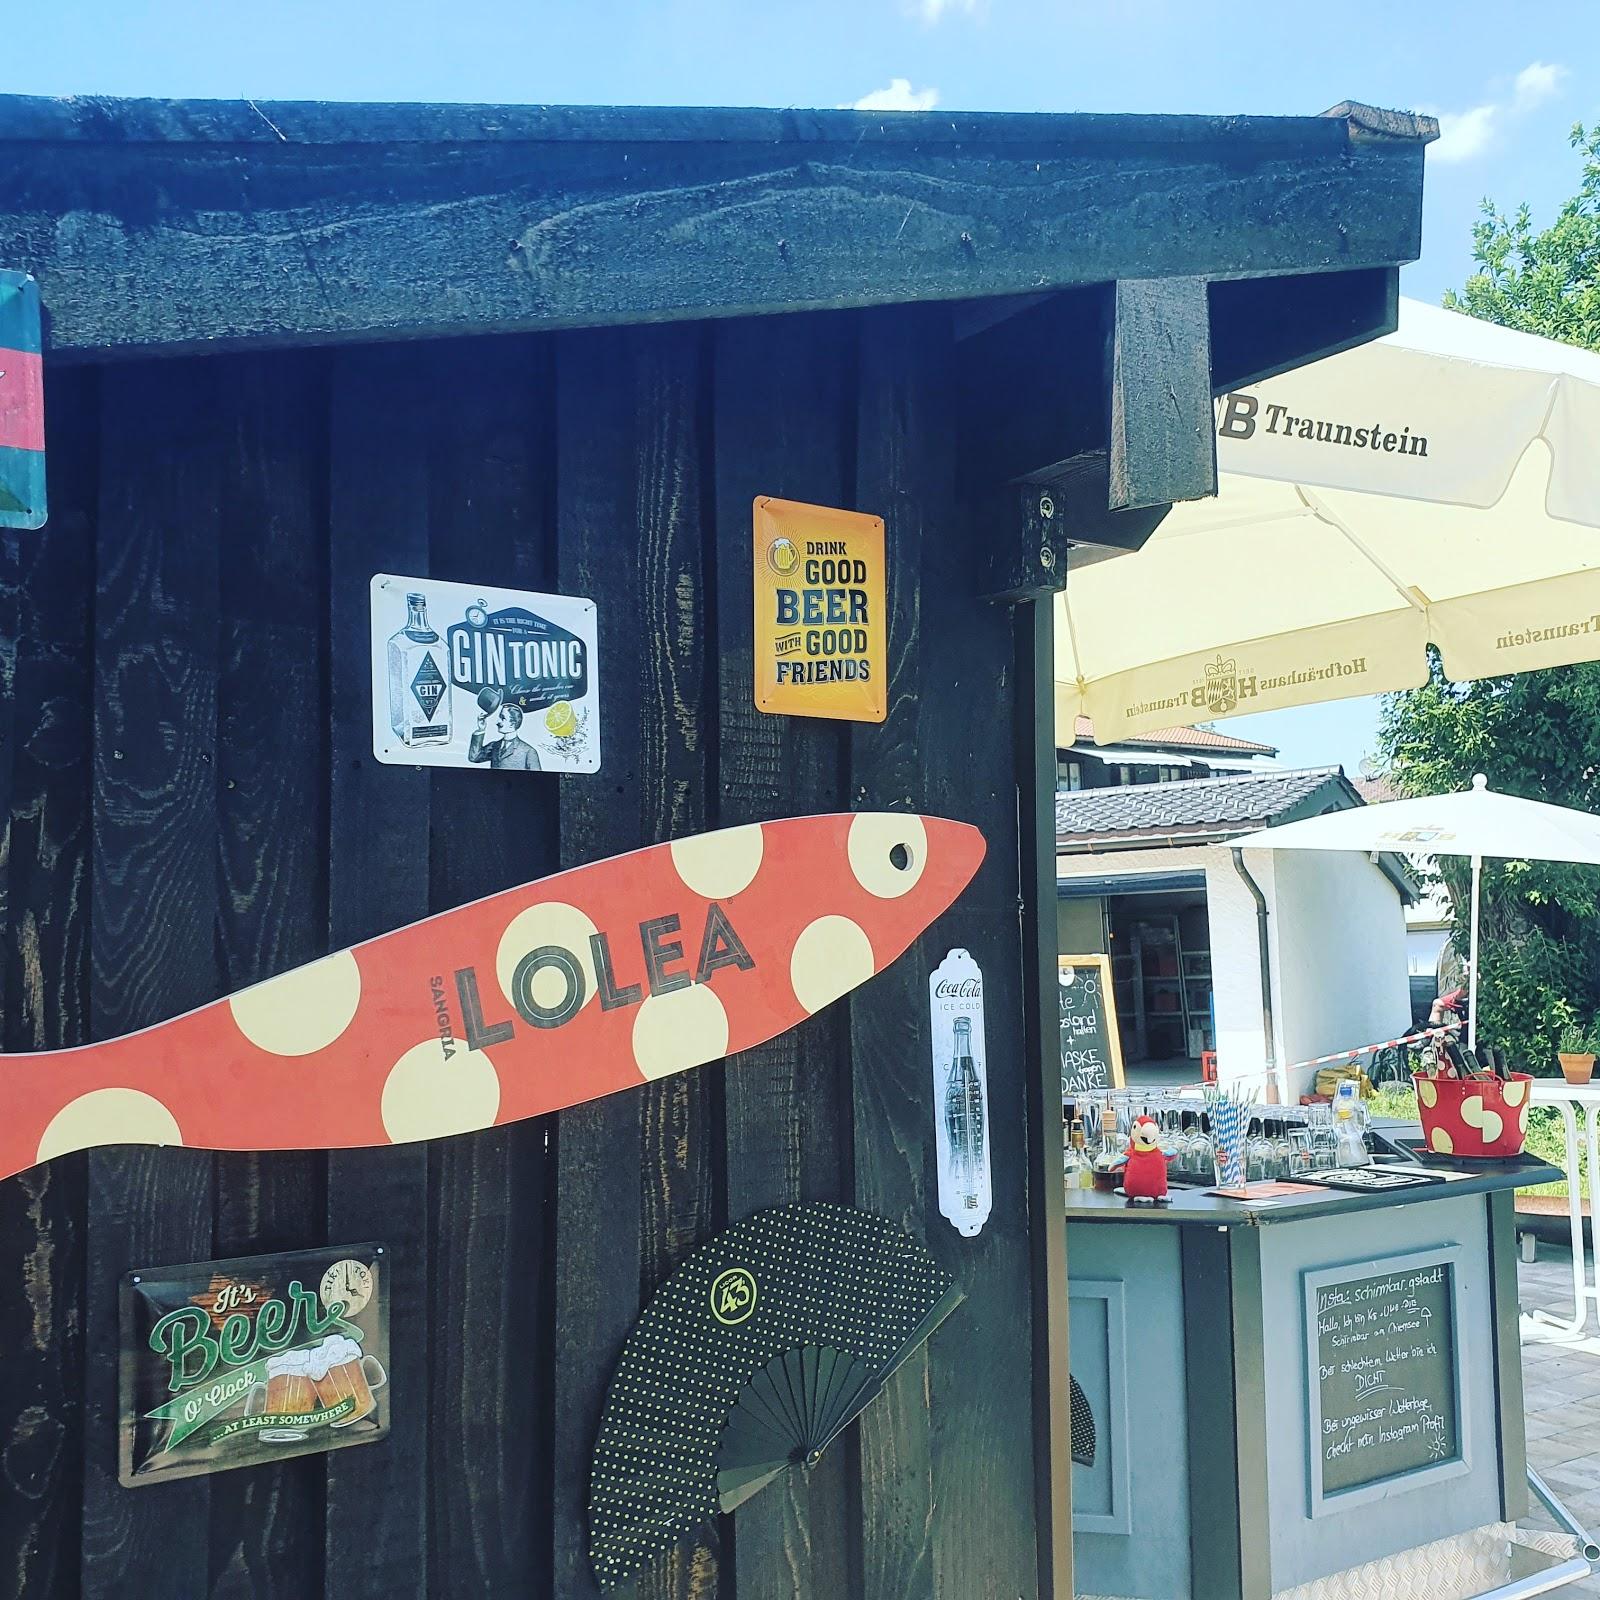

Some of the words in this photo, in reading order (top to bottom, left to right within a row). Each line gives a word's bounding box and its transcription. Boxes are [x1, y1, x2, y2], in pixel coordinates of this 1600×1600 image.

[1265, 403, 1428, 457] Traunstein
[806, 541, 847, 555] DRINK
[805, 559, 867, 585] GOOD
[775, 588, 869, 626] BEER
[775, 636, 801, 652] WITH
[806, 629, 868, 656] GOOD
[452, 629, 507, 686] GIN
[508, 640, 582, 680] TONIC
[776, 659, 870, 685] FRIENDS
[420, 685, 438, 696] GIN
[454, 901, 757, 1052] LOLEA
[934, 978, 982, 999] Coca-Cola
[430, 975, 458, 1062] SANGRIA
[1061, 1074, 1108, 1094] DANKE
[212, 1283, 258, 1314] It's
[720, 1276, 750, 1313] 43
[149, 1280, 365, 1393] Beer
[1319, 1363, 1336, 1380] Bei
[1355, 1370, 1386, 1392] DICHT
[204, 1371, 257, 1408] Clock
[242, 1415, 277, 1429] LEAST
[279, 1401, 350, 1426] SOMEWHERE
[1322, 1418, 1339, 1434] Bei
[1342, 1406, 1386, 1430] ungewisser
[1379, 1422, 1419, 1444] Instagram
[1420, 1414, 1445, 1434] Profil
